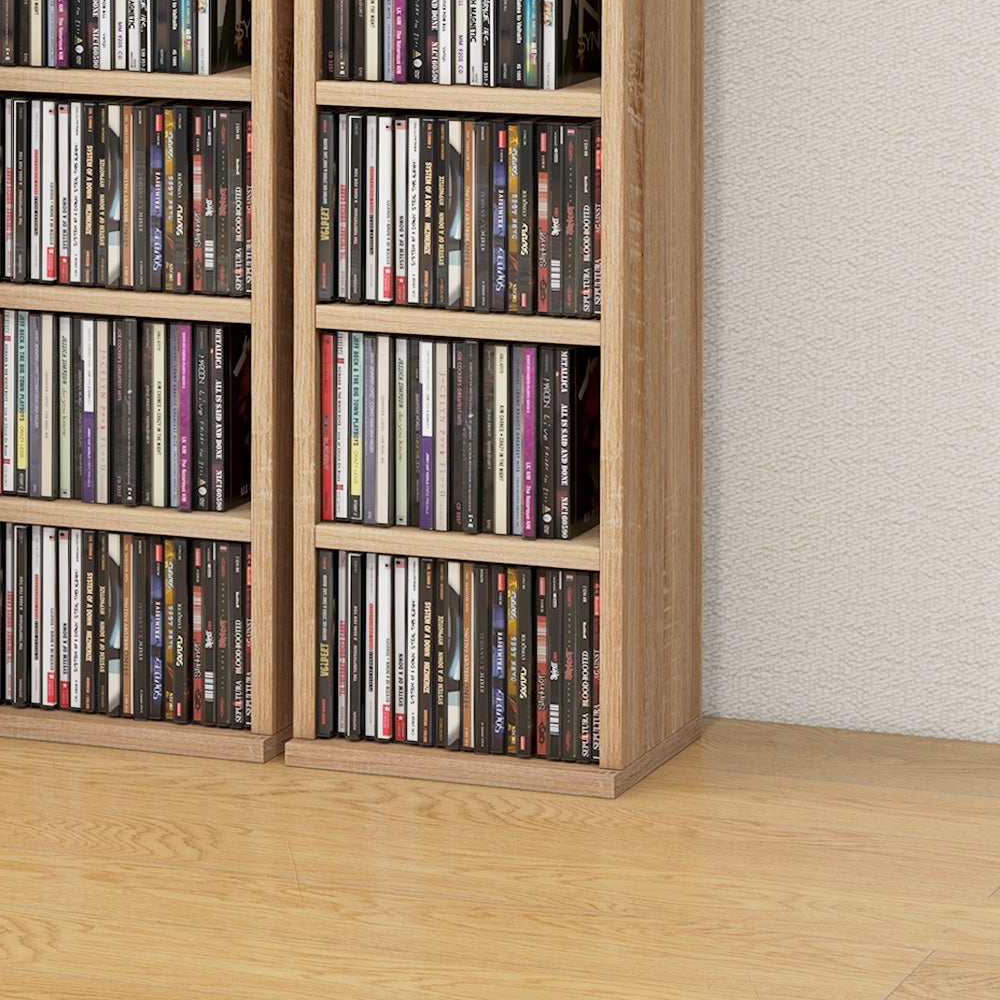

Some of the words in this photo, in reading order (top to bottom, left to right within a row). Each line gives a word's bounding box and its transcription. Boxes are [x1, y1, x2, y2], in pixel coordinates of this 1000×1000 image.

[424, 162, 432, 184] SYSTEM
[424, 200, 432, 217] DOWN
[582, 268, 591, 312] SEPULTURA
[560, 351, 568, 392] METALLICA
[215, 394, 222, 403] IS
[560, 403, 568, 418] ALL
[560, 419, 568, 427] IS
[560, 428, 568, 446] SAID
[560, 448, 568, 464] AND
[560, 465, 568, 486] DONE
[423, 601, 432, 624] SYSTEM
[423, 640, 432, 657] DOWN
[233, 680, 242, 723] SEPULTURA
[579, 713, 590, 757] SEPULTURA
